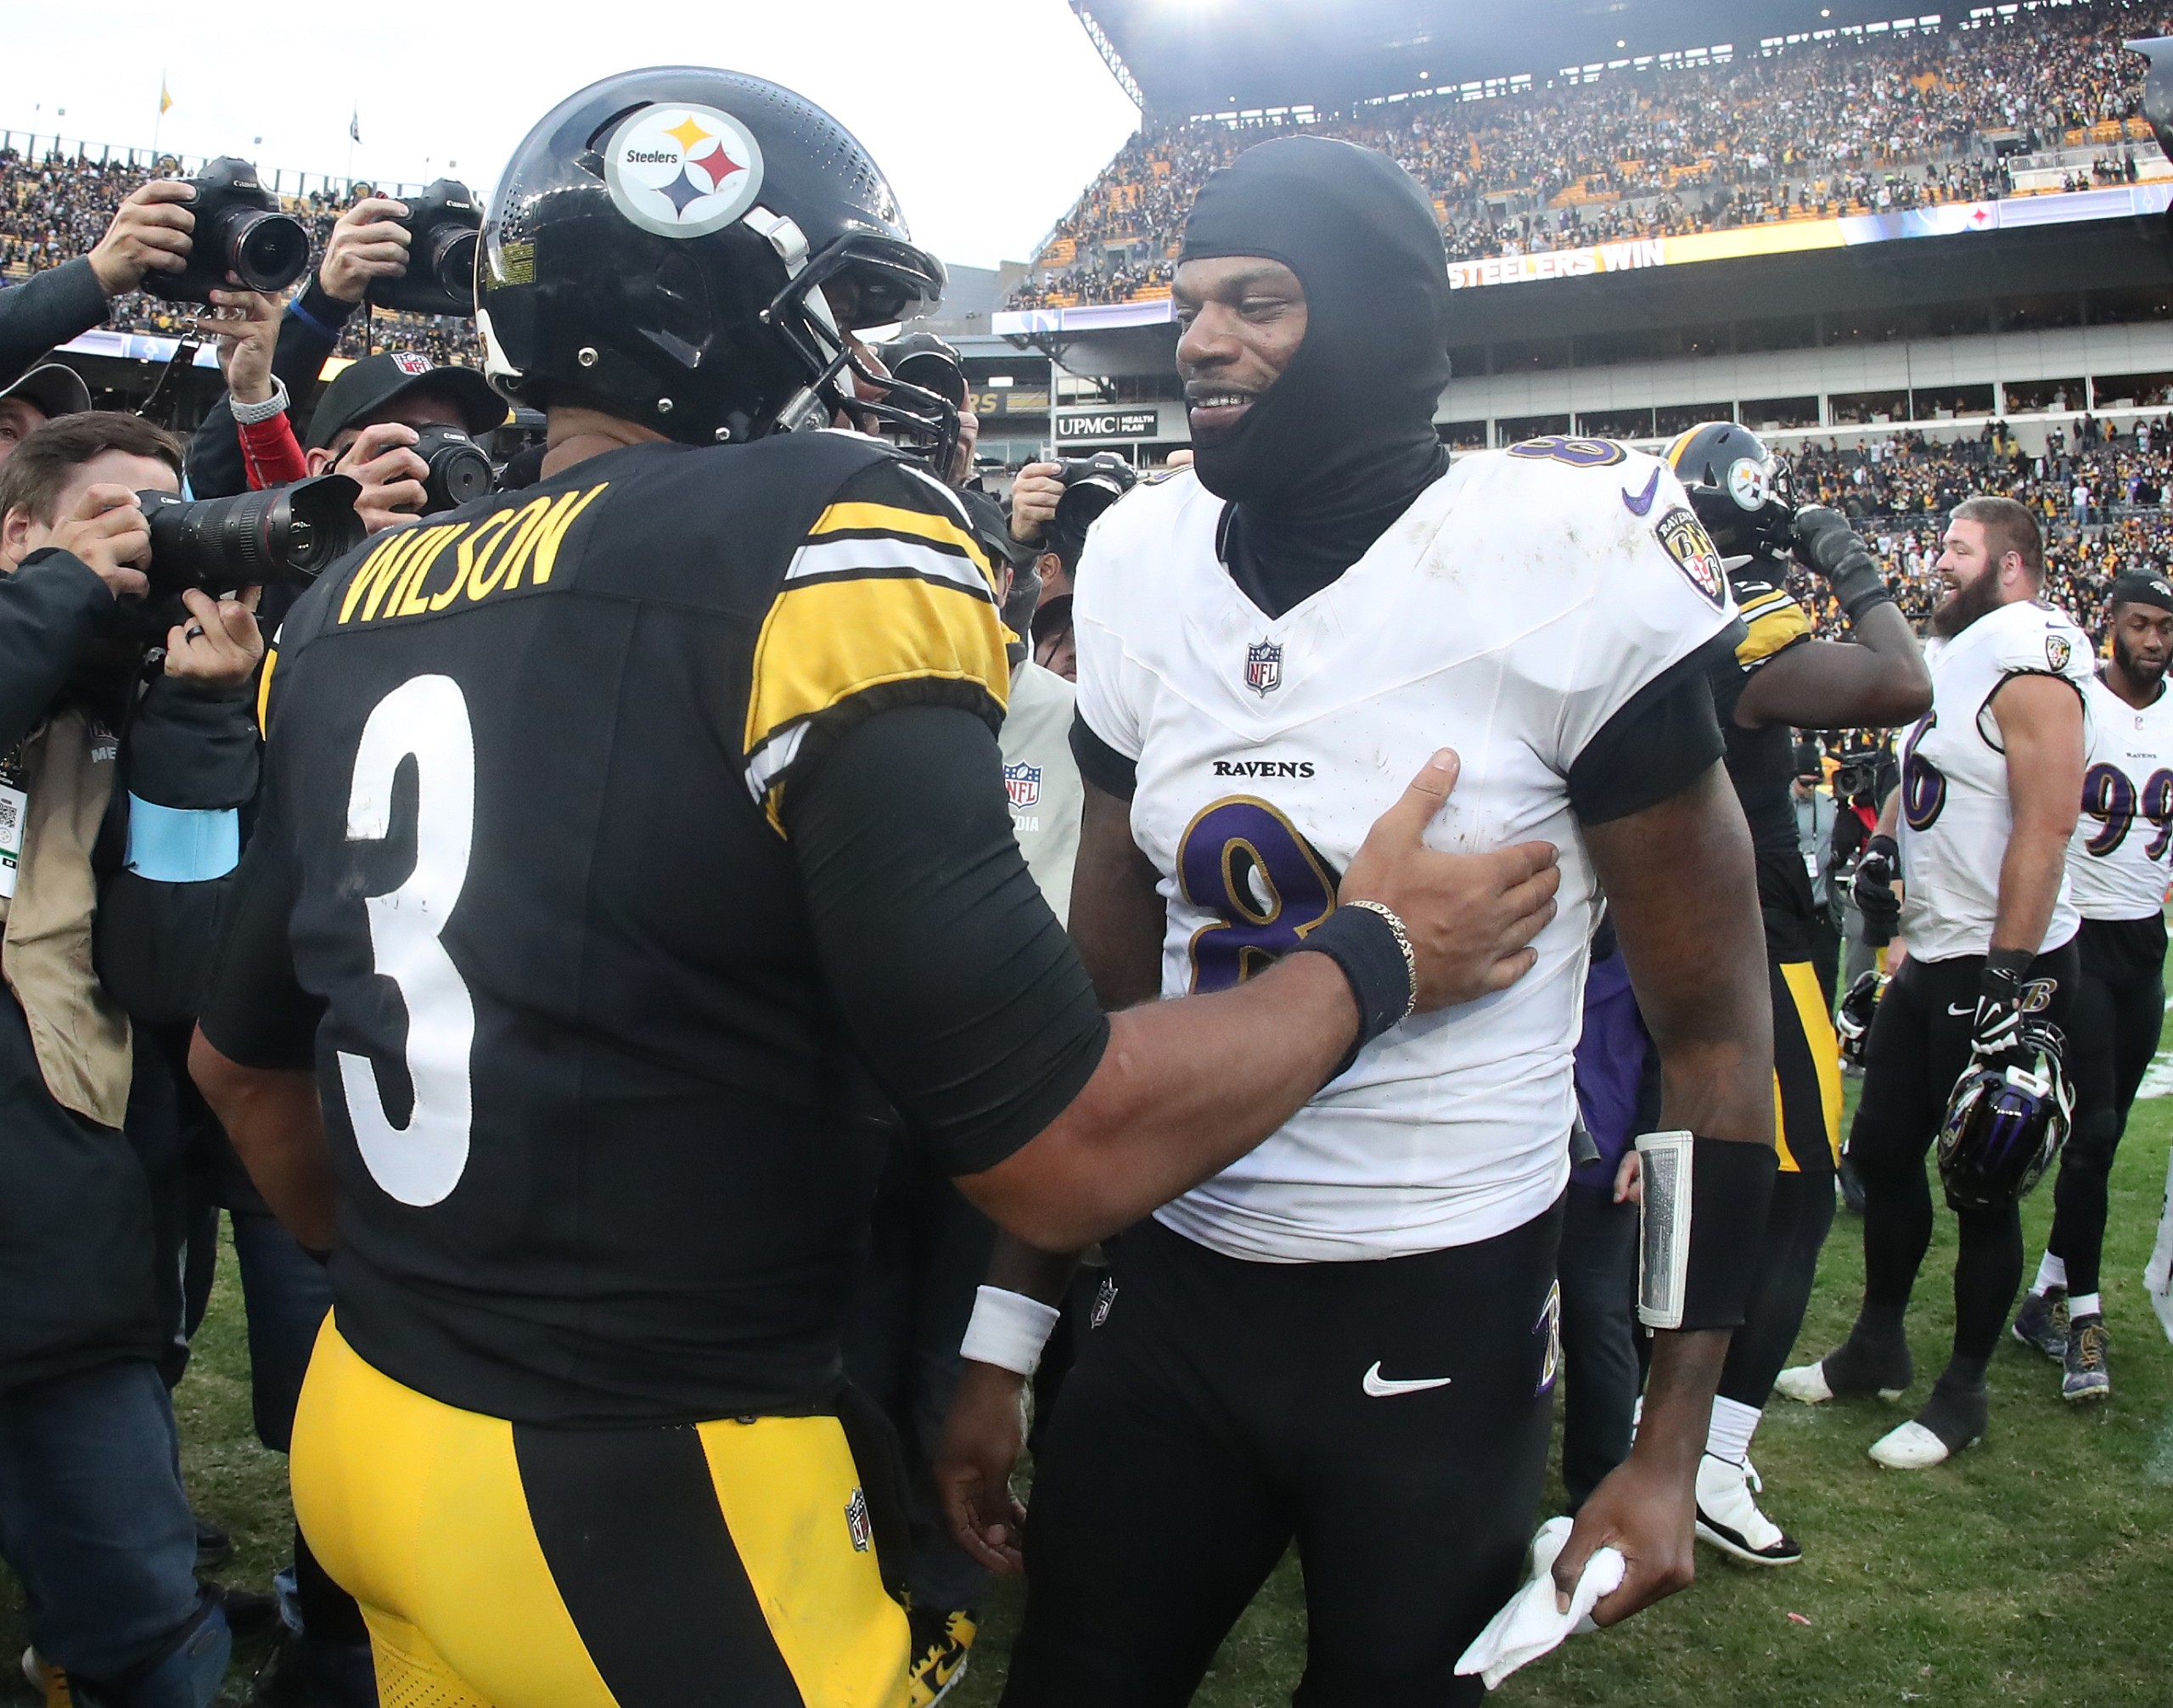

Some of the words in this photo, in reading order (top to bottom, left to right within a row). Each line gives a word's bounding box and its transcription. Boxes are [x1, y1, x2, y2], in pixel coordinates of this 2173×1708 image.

[626, 149, 678, 164] Steelers
[233, 180, 257, 188] Canon
[446, 199, 470, 210] Canon
[1447, 247, 1596, 289] STEELERS
[1601, 238, 1665, 272] WIN
[1058, 416, 1115, 435] UPMC
[1121, 415, 1154, 424] HEALTH
[1121, 424, 1144, 432] PLAN
[443, 432, 466, 441] Canon
[1659, 511, 1694, 537] RAVEN
[338, 481, 609, 624] WILSON
[1249, 663, 1276, 685] NFL
[1213, 761, 1315, 778] RAVENS
[1007, 780, 1036, 803] NFL
[2080, 762, 2173, 861] 99
[1014, 814, 1039, 832] DIA
[337, 673, 475, 1207] 3
